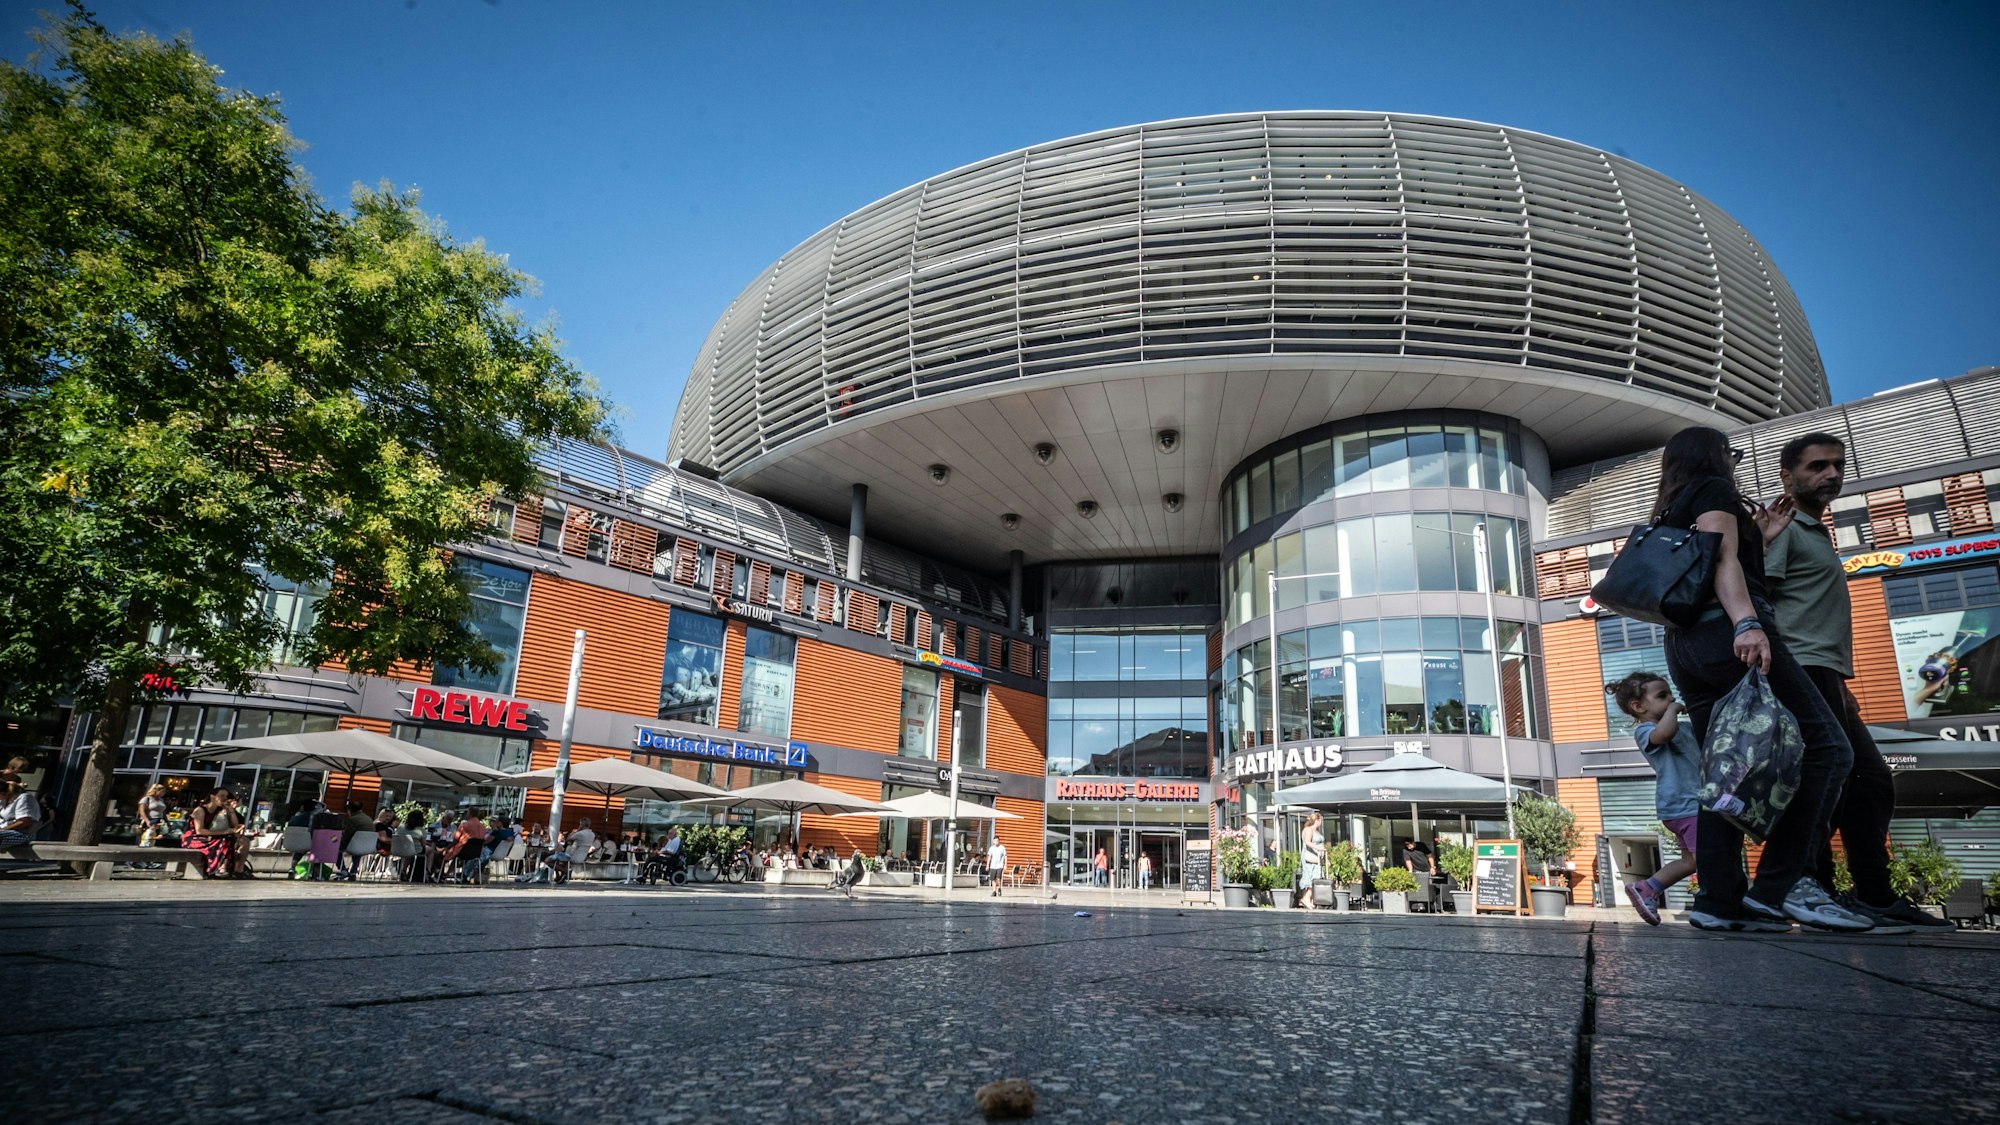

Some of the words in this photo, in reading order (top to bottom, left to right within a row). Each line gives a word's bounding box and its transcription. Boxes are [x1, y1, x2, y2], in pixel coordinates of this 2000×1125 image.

[1842, 552, 1903, 571] SMYTHS
[1908, 549, 1943, 561] TOYS
[735, 601, 773, 622] SATURN
[411, 687, 529, 732] REWE
[637, 728, 728, 757] Deutsche
[732, 740, 776, 763] Bank
[1235, 744, 1343, 777] RATHAUS
[1882, 754, 1918, 763] Brasserie
[939, 769, 952, 781] C&A
[1056, 778, 1199, 801] RATHAUS-GALERIE
